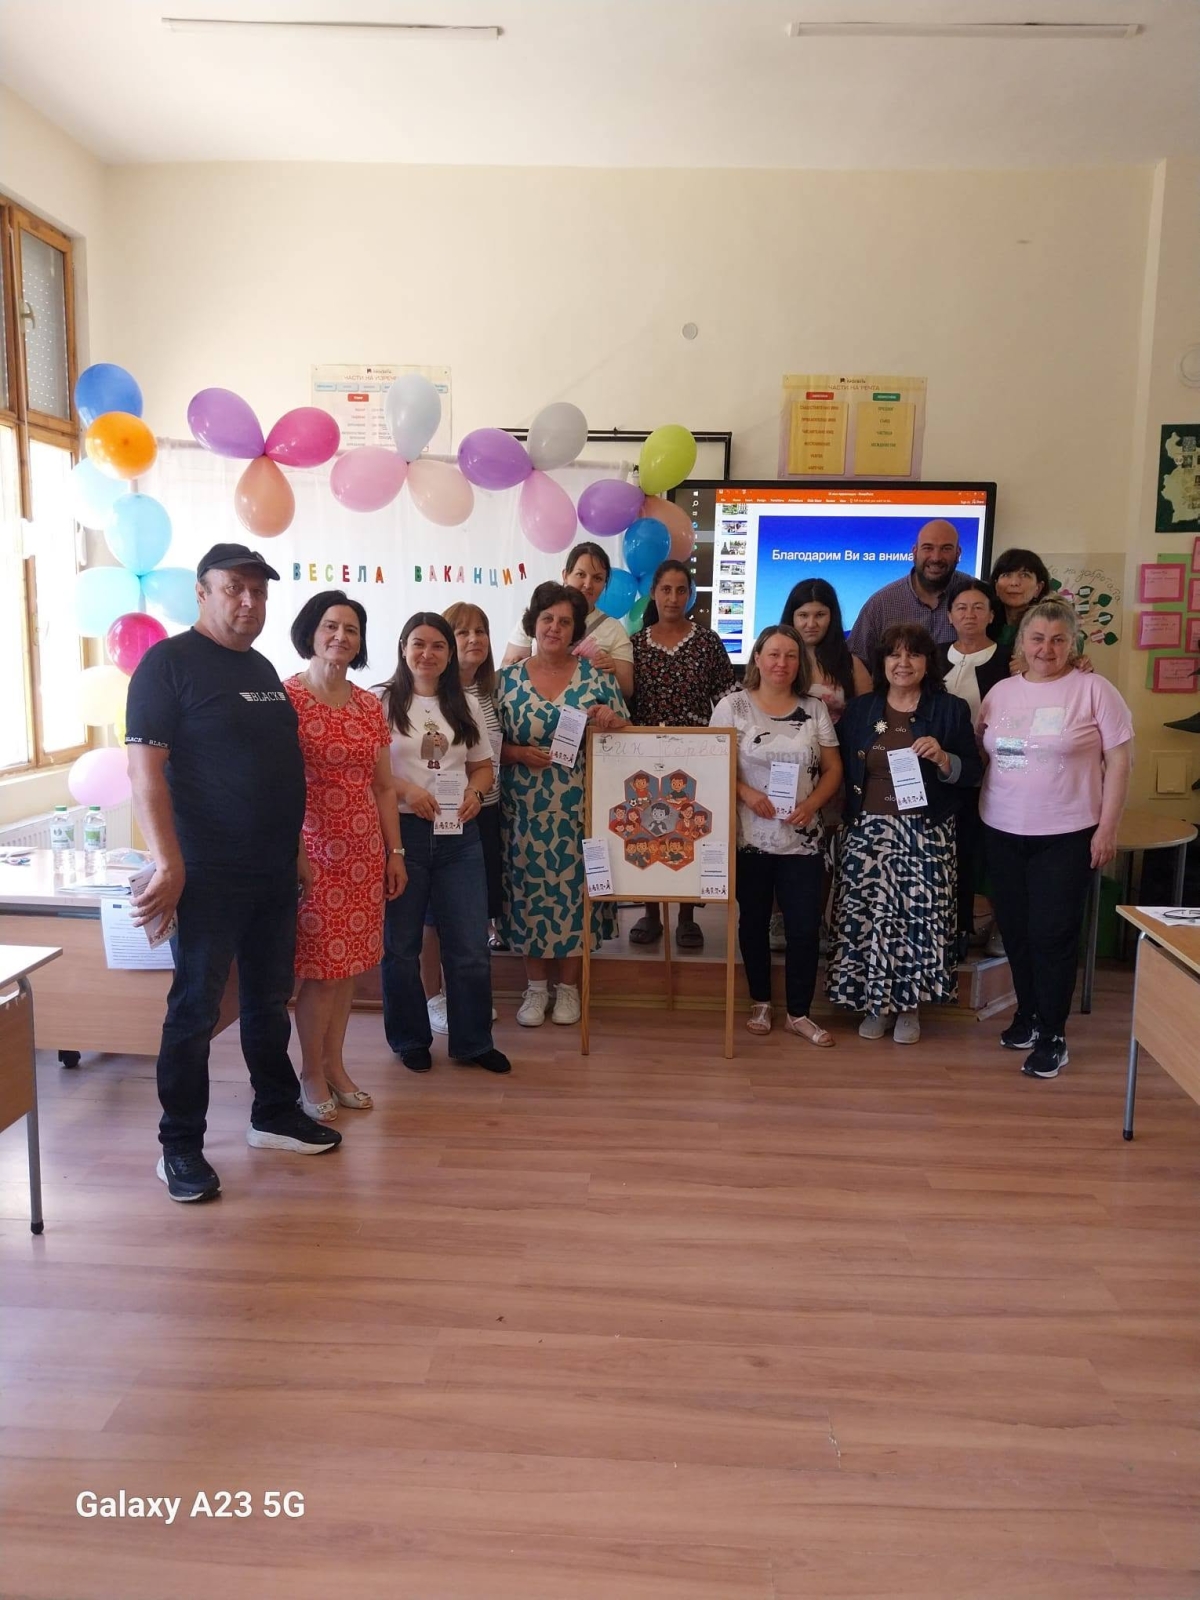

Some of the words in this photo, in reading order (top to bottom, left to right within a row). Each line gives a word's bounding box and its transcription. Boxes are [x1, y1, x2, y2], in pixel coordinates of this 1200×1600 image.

[772, 549, 841, 562] Благодарим
[844, 550, 860, 561] Ви
[863, 552, 875, 561] за
[292, 562, 385, 584] ВЕСЕЛА
[414, 562, 527, 588] ВАКАНЦИЯ
[251, 692, 279, 702] BLACK
